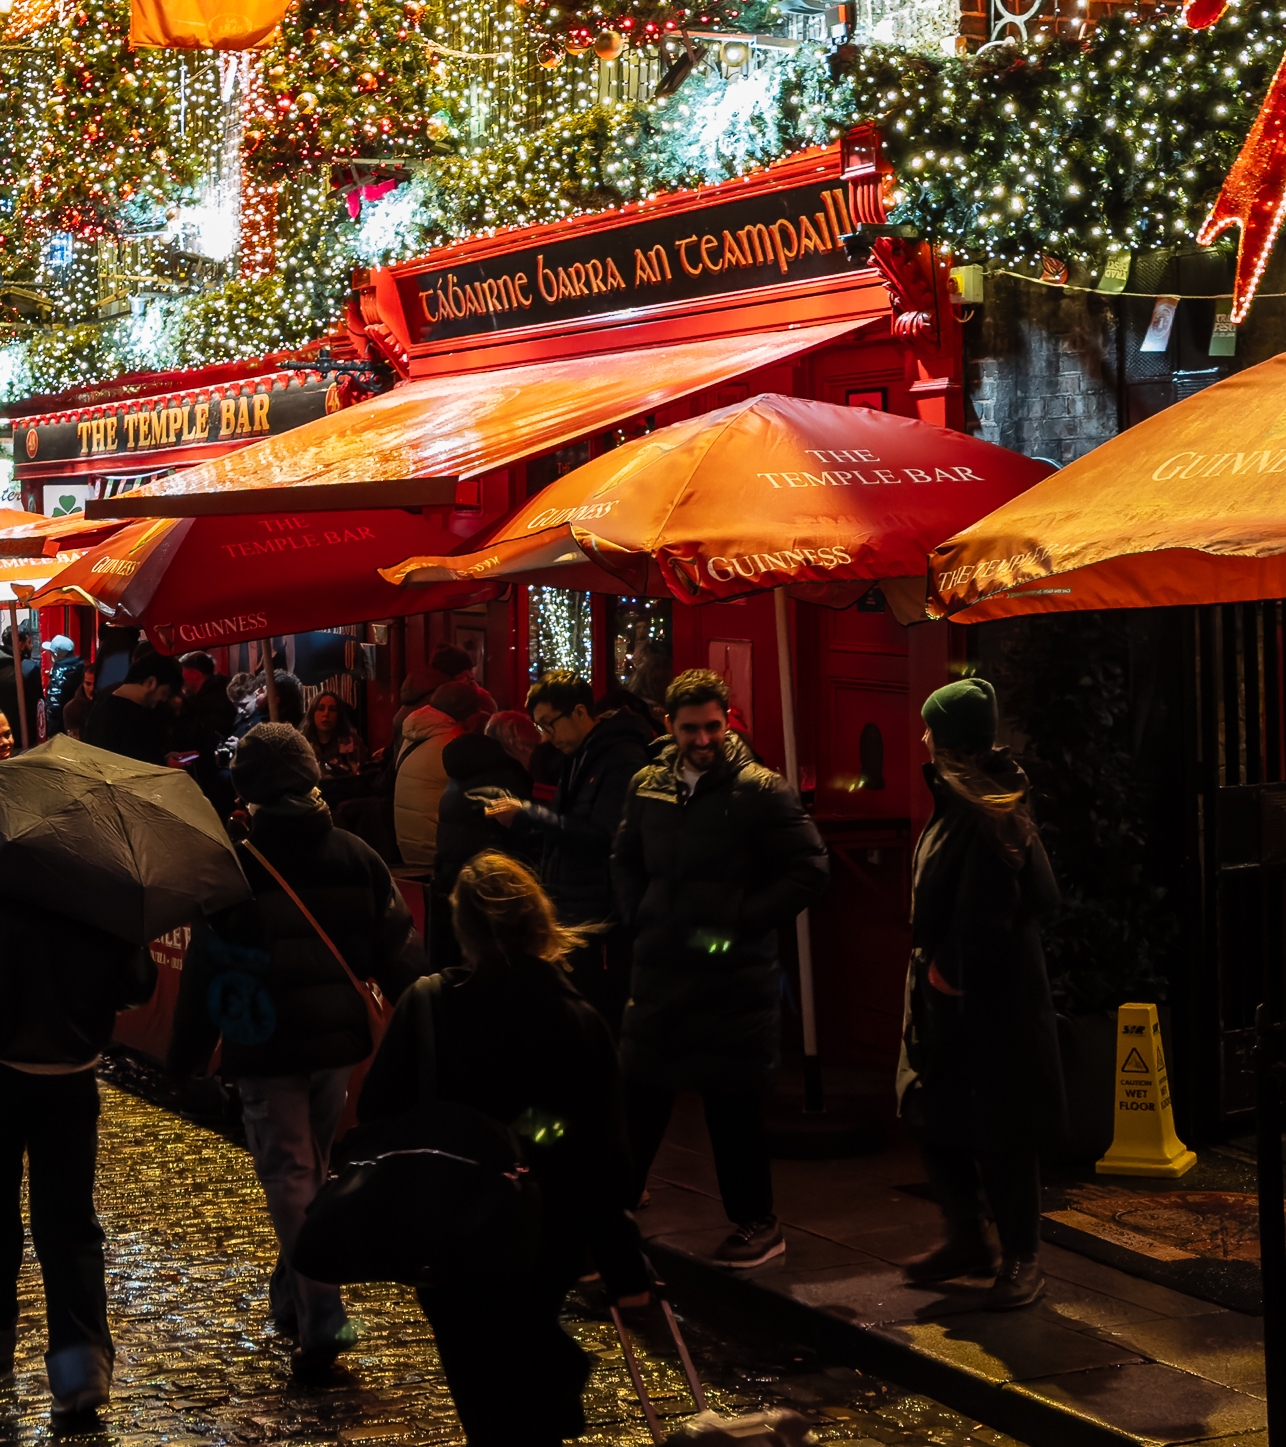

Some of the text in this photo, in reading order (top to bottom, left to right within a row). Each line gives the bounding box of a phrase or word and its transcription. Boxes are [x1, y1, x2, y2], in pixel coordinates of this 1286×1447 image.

[77, 393, 271, 454] THE TEMPLE BAR
[805, 448, 881, 464] THE
[756, 466, 986, 490] TEMPLE BAR
[258, 515, 311, 533] THE
[527, 500, 620, 530] GUINNESS
[221, 526, 376, 559] TEMPLE BAR
[57, 550, 89, 565] BA
[91, 556, 140, 577] GUINNESS
[707, 545, 853, 584] GUINNESS
[938, 565, 975, 592] THE
[179, 611, 268, 643] GUINNESS
[1125, 1089, 1148, 1098] WET
[1119, 1101, 1155, 1111] FLOOR
